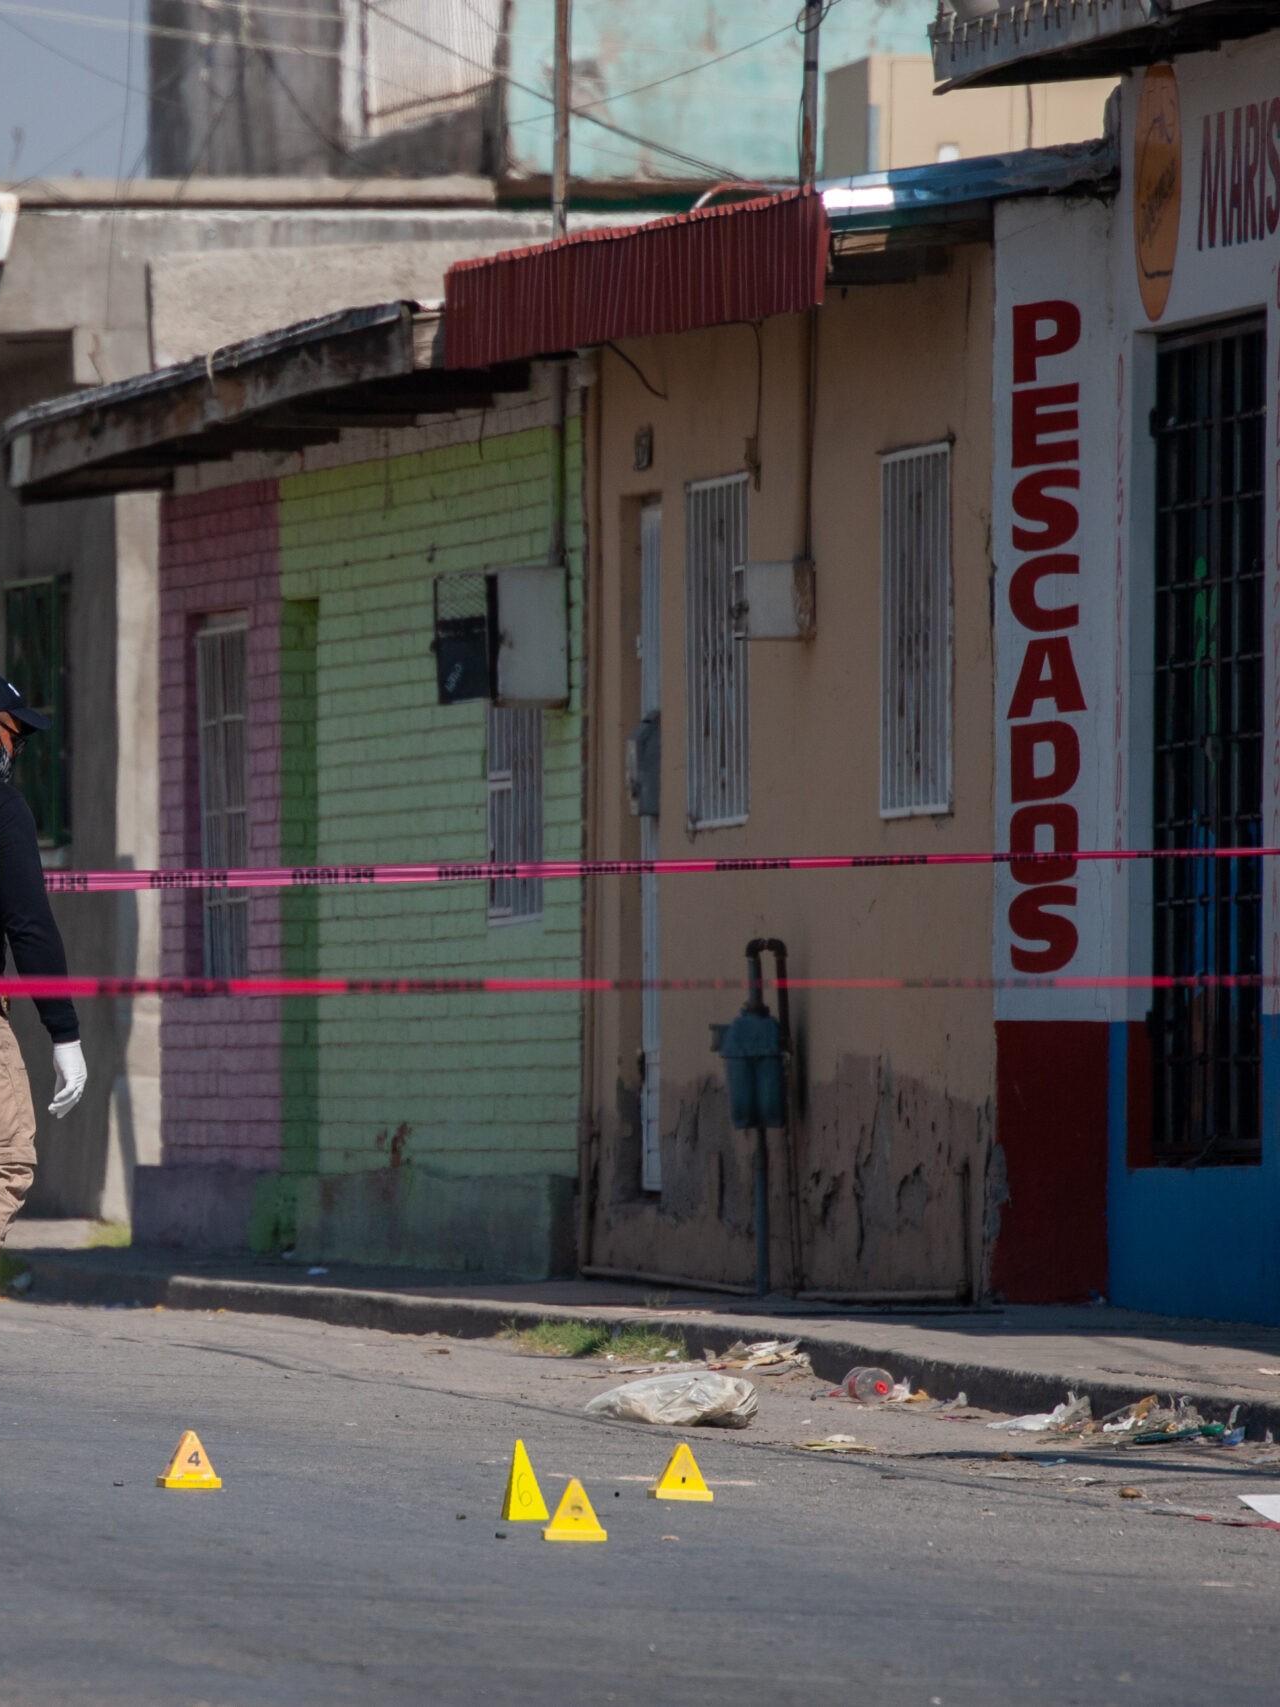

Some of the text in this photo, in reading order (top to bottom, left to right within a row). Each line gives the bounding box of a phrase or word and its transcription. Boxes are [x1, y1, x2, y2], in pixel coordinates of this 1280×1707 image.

[1007, 300, 1087, 974] PESCADOS
[187, 1451, 201, 1467] 4
[517, 1472, 532, 1507] 6
